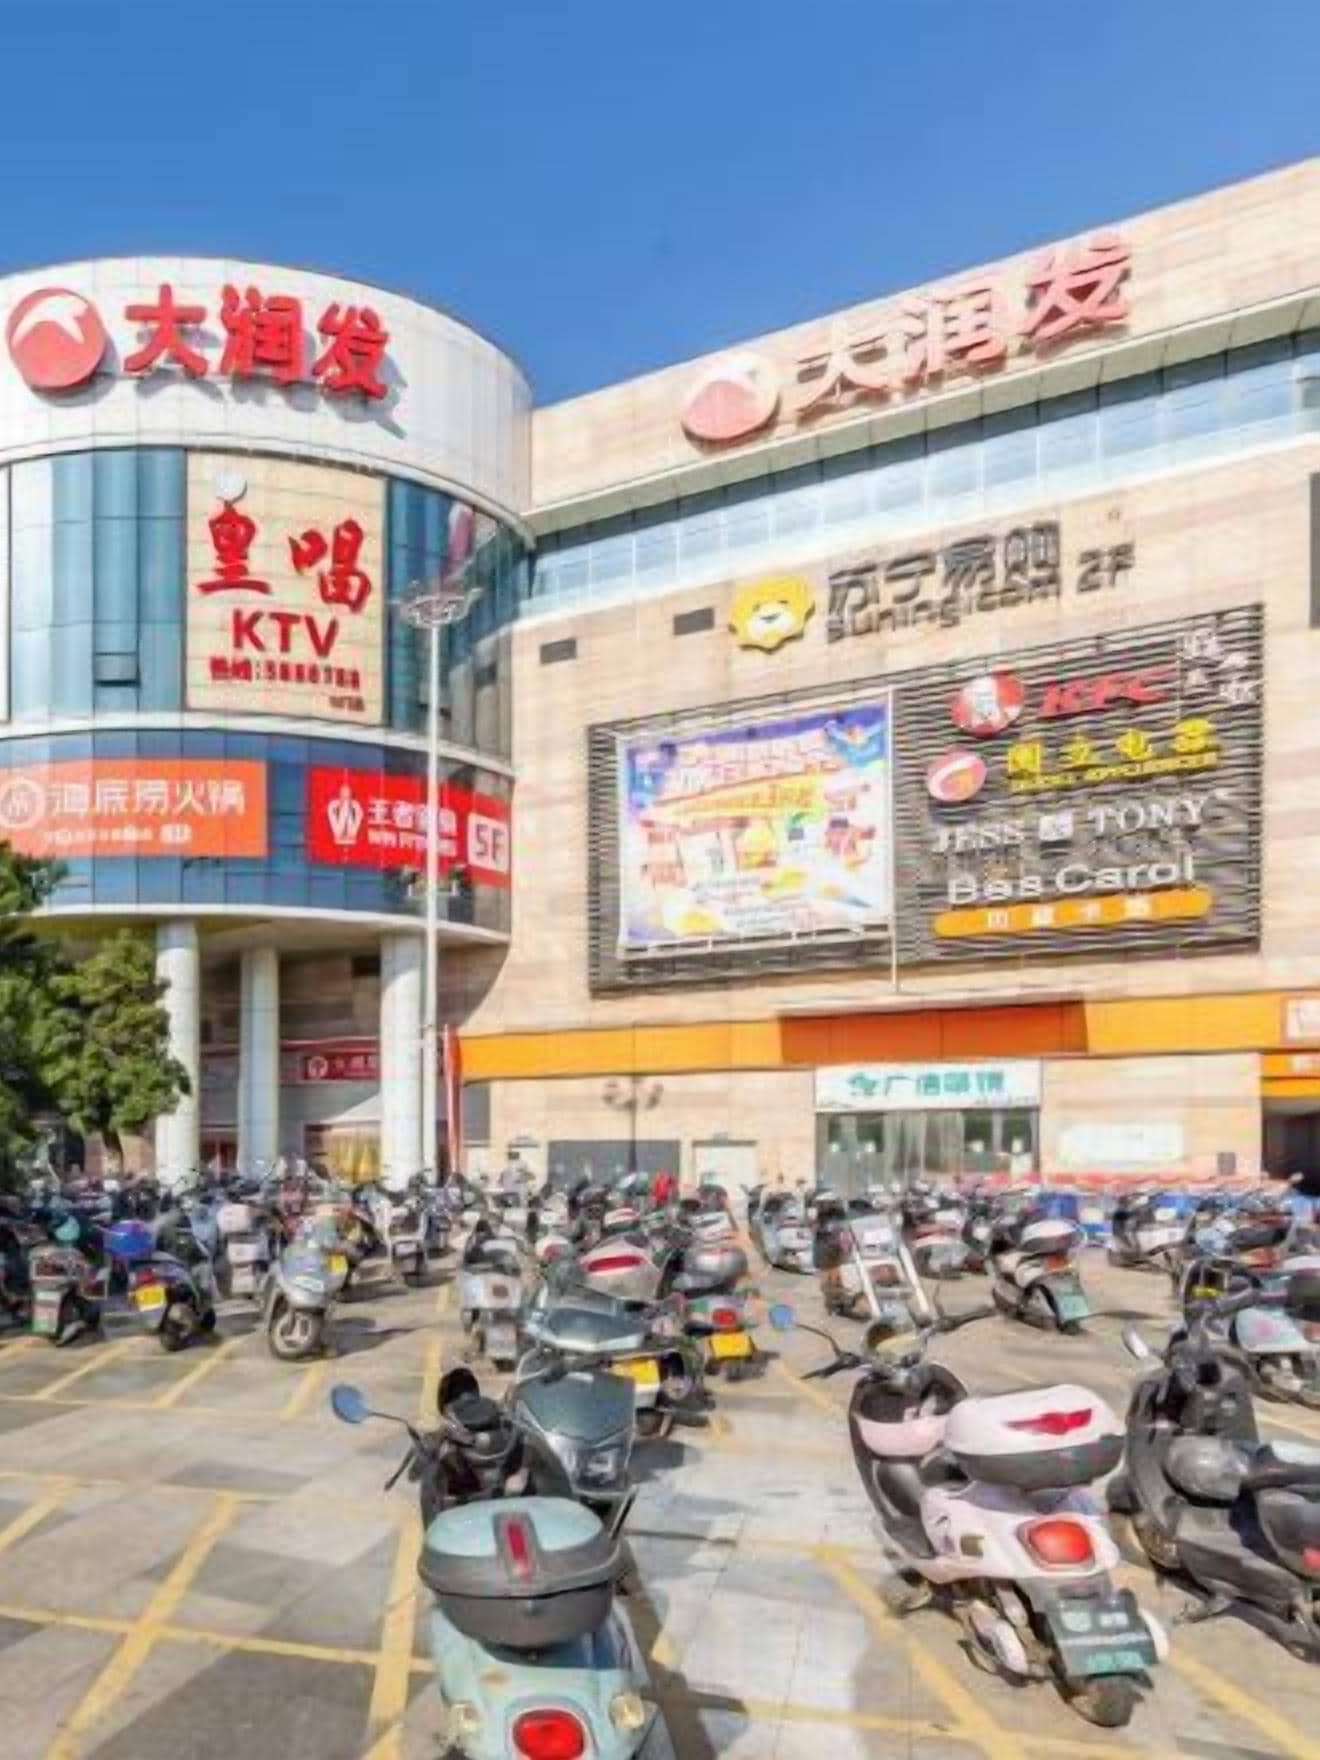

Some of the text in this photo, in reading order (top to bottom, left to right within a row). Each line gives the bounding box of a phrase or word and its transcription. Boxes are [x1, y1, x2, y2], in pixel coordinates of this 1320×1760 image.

[122, 282, 389, 401] 大润发
[796, 231, 1132, 418] 大润发
[1076, 539, 1134, 595] 2F
[232, 608, 339, 658] KTV
[49, 779, 246, 817] 海底捞火锅
[1089, 794, 1209, 836] TONY
[1055, 855, 1195, 894] Carol
